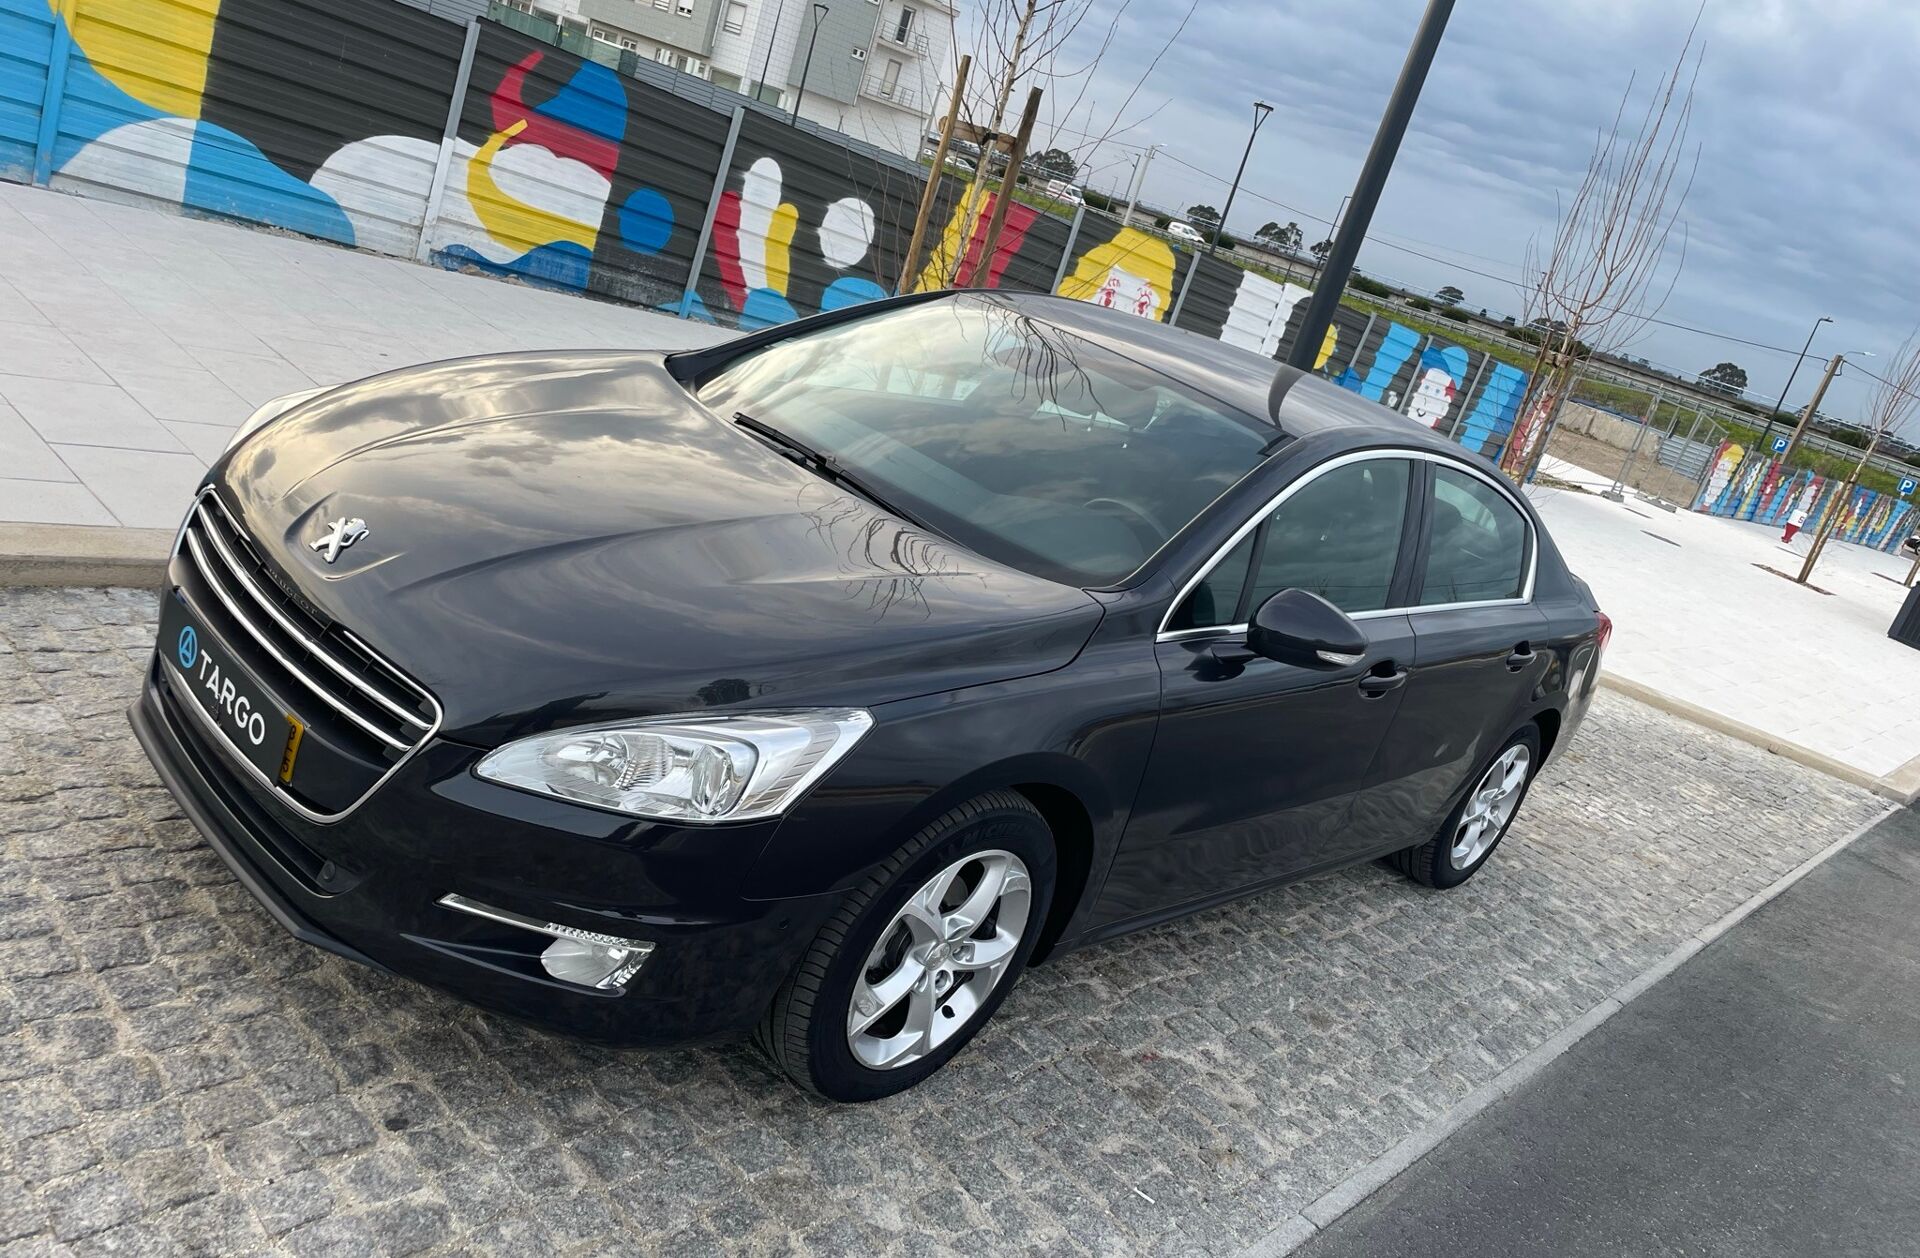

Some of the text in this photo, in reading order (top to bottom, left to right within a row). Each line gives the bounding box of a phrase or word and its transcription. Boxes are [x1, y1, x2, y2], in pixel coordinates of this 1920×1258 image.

[1774, 440, 1786, 450] P
[1900, 480, 1912, 490] P
[200, 648, 265, 745] TARGO
